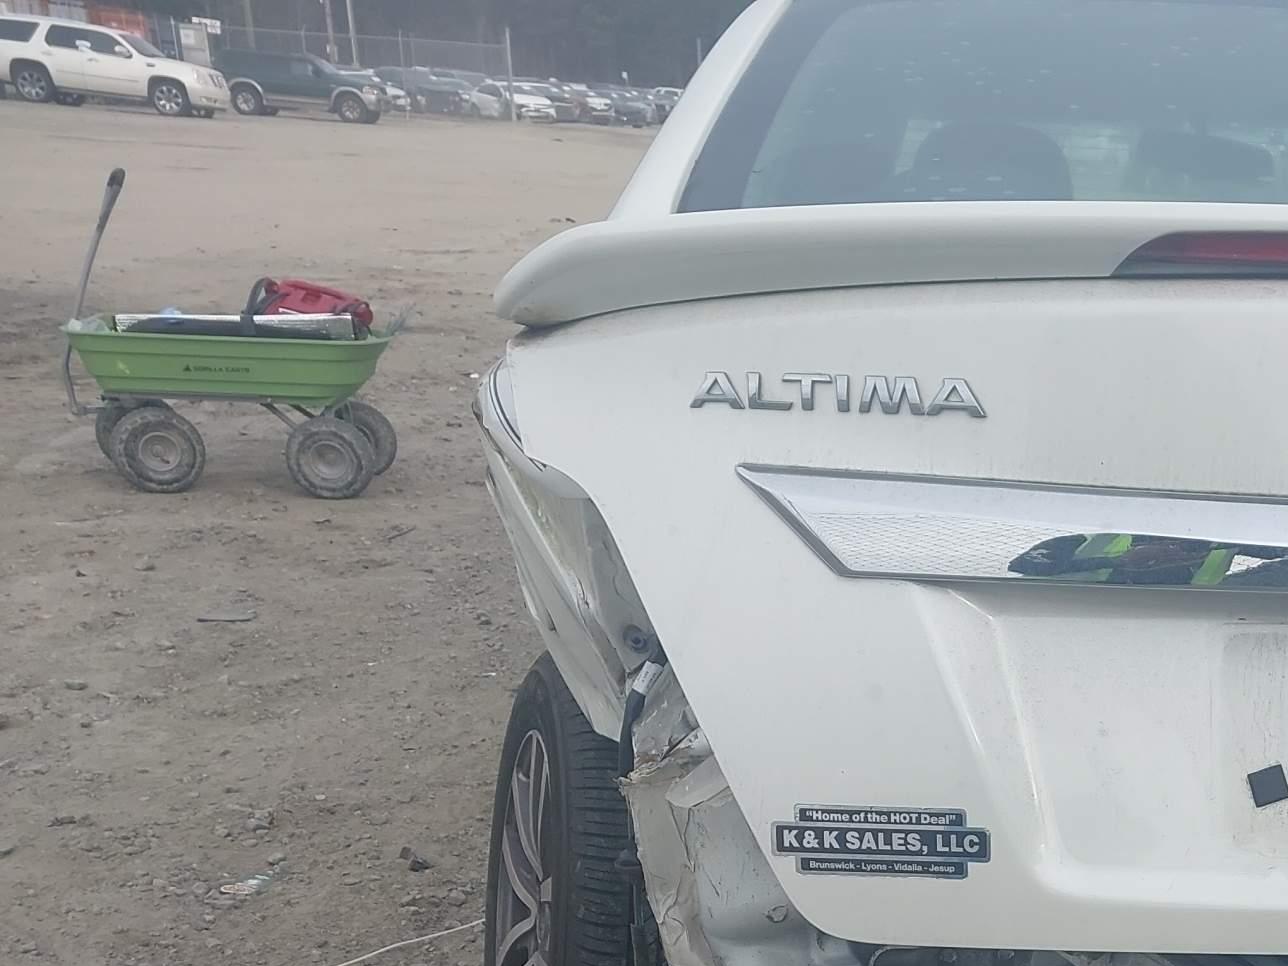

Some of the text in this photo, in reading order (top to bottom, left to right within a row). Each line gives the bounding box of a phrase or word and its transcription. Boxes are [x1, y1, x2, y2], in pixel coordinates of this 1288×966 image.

[690, 371, 988, 418] ALTIMA
[852, 811, 866, 823] of
[867, 812, 888, 824] the
[890, 812, 919, 825] HOT
[783, 829, 980, 854] K & K SALES, LLC
[809, 860, 855, 870] Brunswick
[861, 862, 887, 873] Lyons
[928, 864, 955, 874] Jesup
